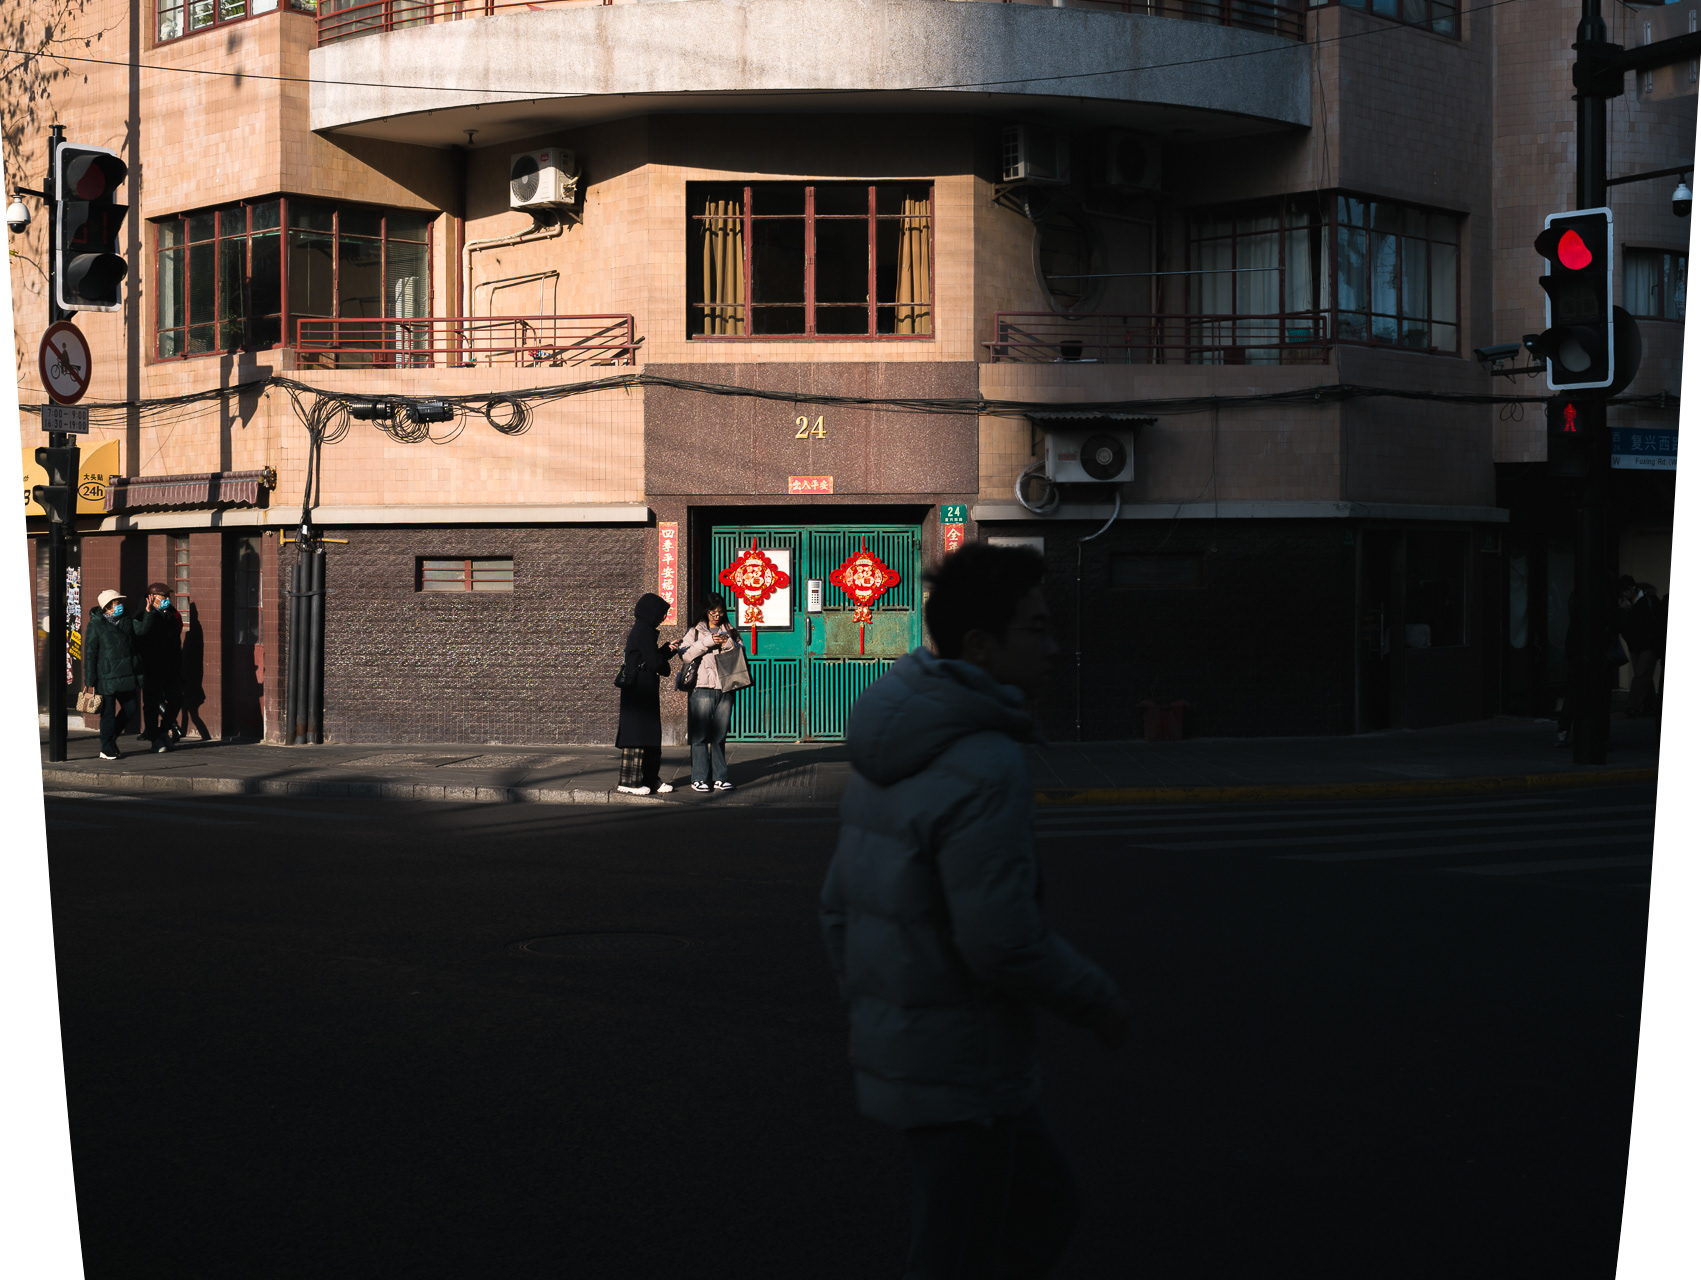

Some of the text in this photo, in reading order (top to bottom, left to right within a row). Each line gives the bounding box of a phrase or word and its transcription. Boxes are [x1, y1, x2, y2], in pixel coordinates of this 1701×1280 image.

[795, 415, 827, 439] 24
[1613, 457, 1621, 465] W
[1635, 458, 1655, 466] Fuxing
[83, 473, 104, 482] 大头贴
[83, 485, 104, 497] 24h
[792, 479, 829, 491] 出入平安
[947, 506, 961, 517] 24
[743, 565, 764, 587] 福
[853, 565, 875, 587] 福
